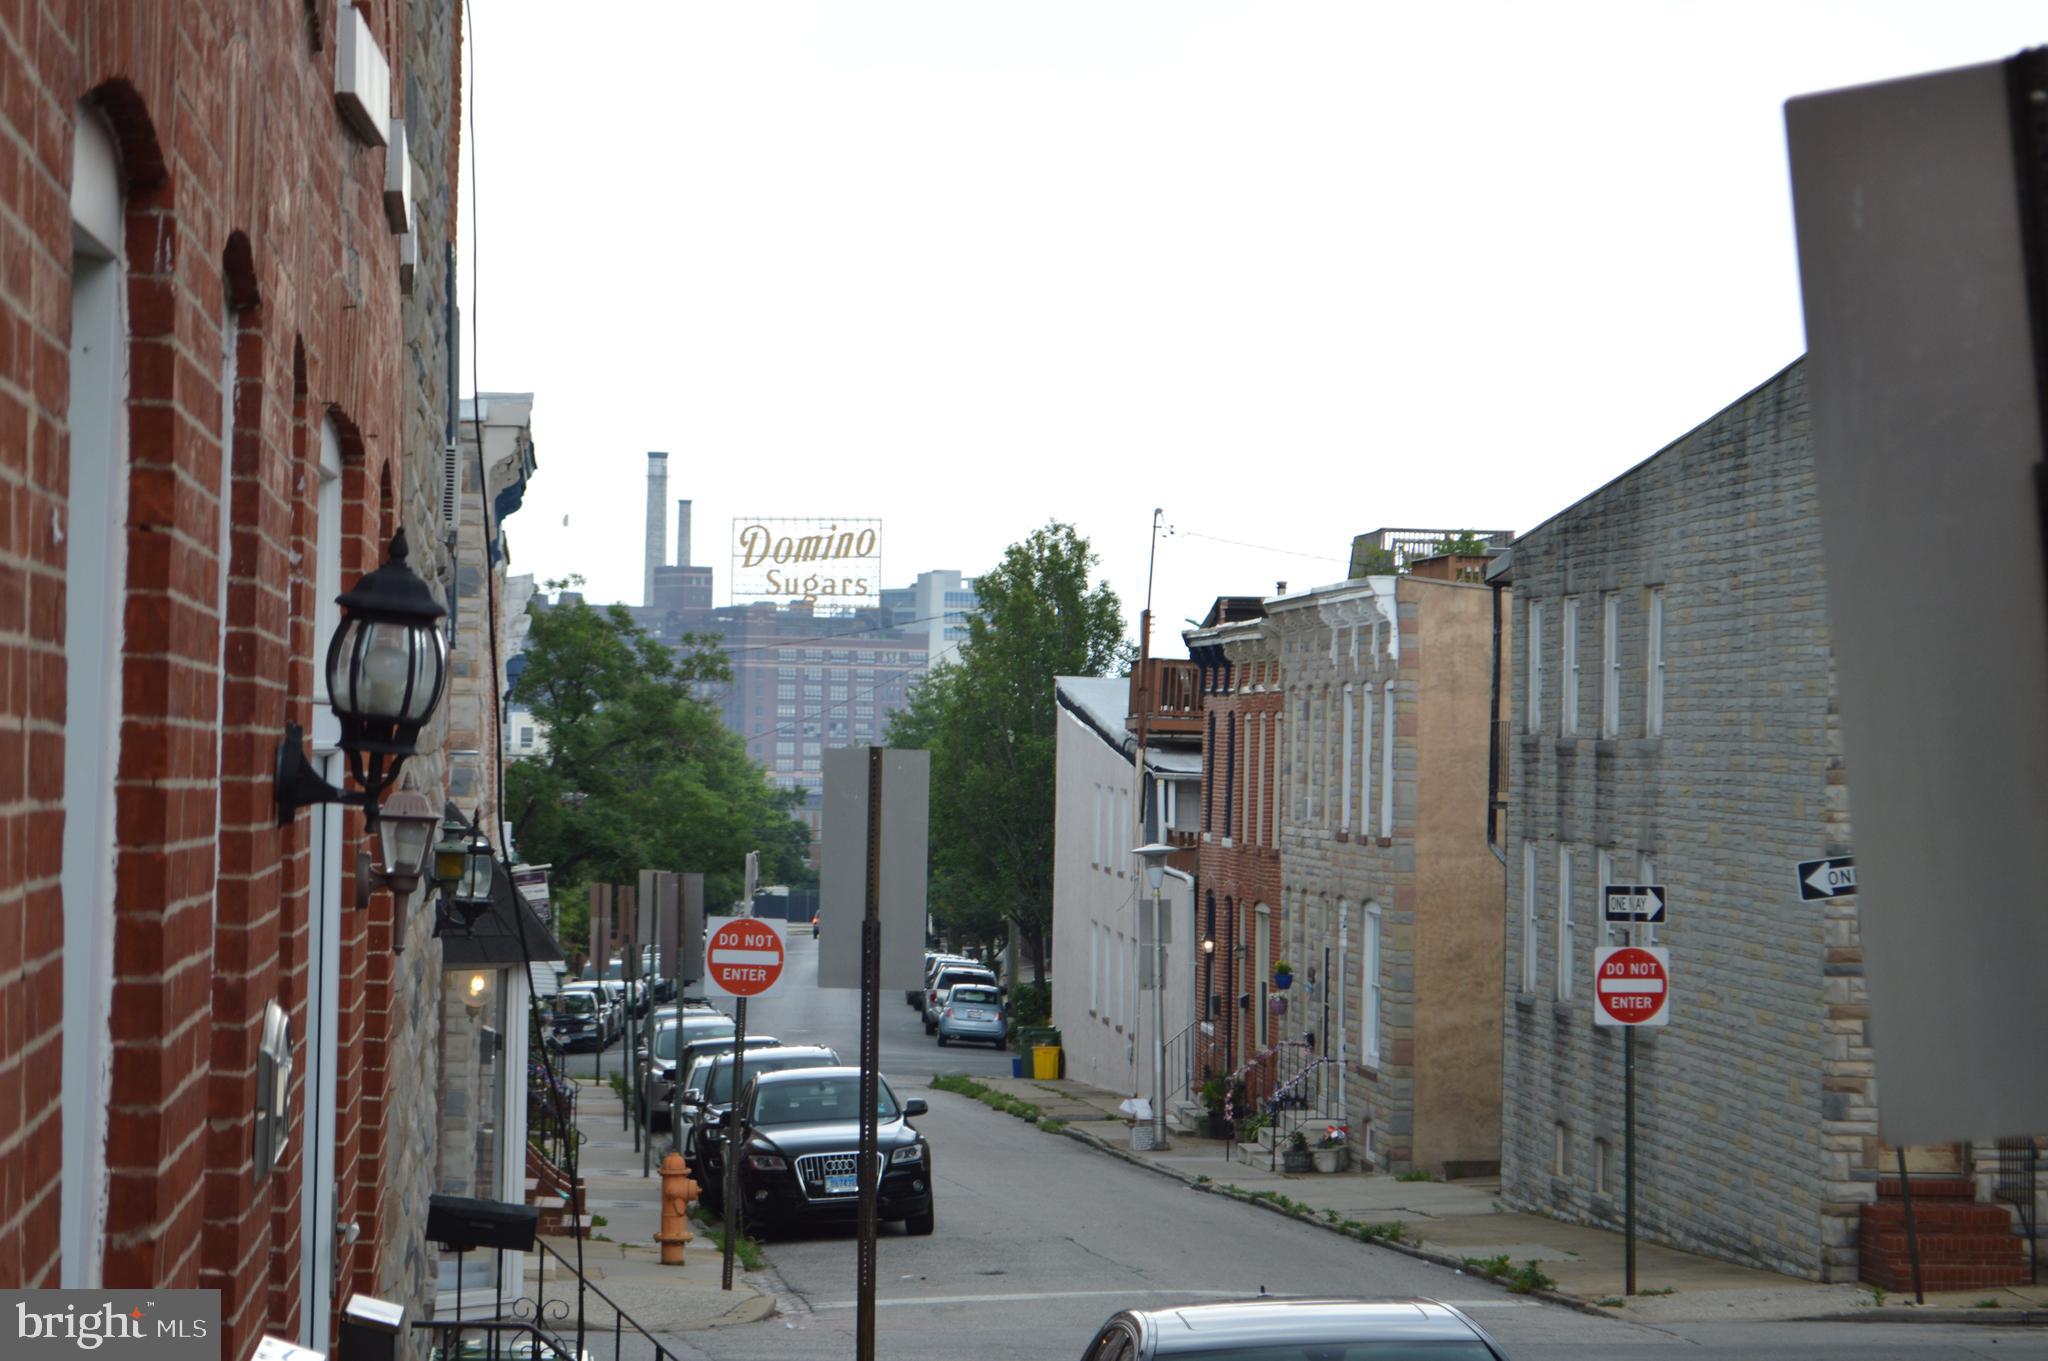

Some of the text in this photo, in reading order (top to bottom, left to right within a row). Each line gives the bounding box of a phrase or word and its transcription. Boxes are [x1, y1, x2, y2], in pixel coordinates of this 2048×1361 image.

[739, 523, 876, 568] Domino
[766, 569, 868, 603] Sugars
[1828, 868, 1856, 885] ON
[1611, 896, 1627, 911] ONE
[719, 933, 774, 948] DO NOT
[723, 967, 767, 982] ENTER
[1606, 962, 1657, 976] DO NOT
[1611, 996, 1653, 1009] ENTER
